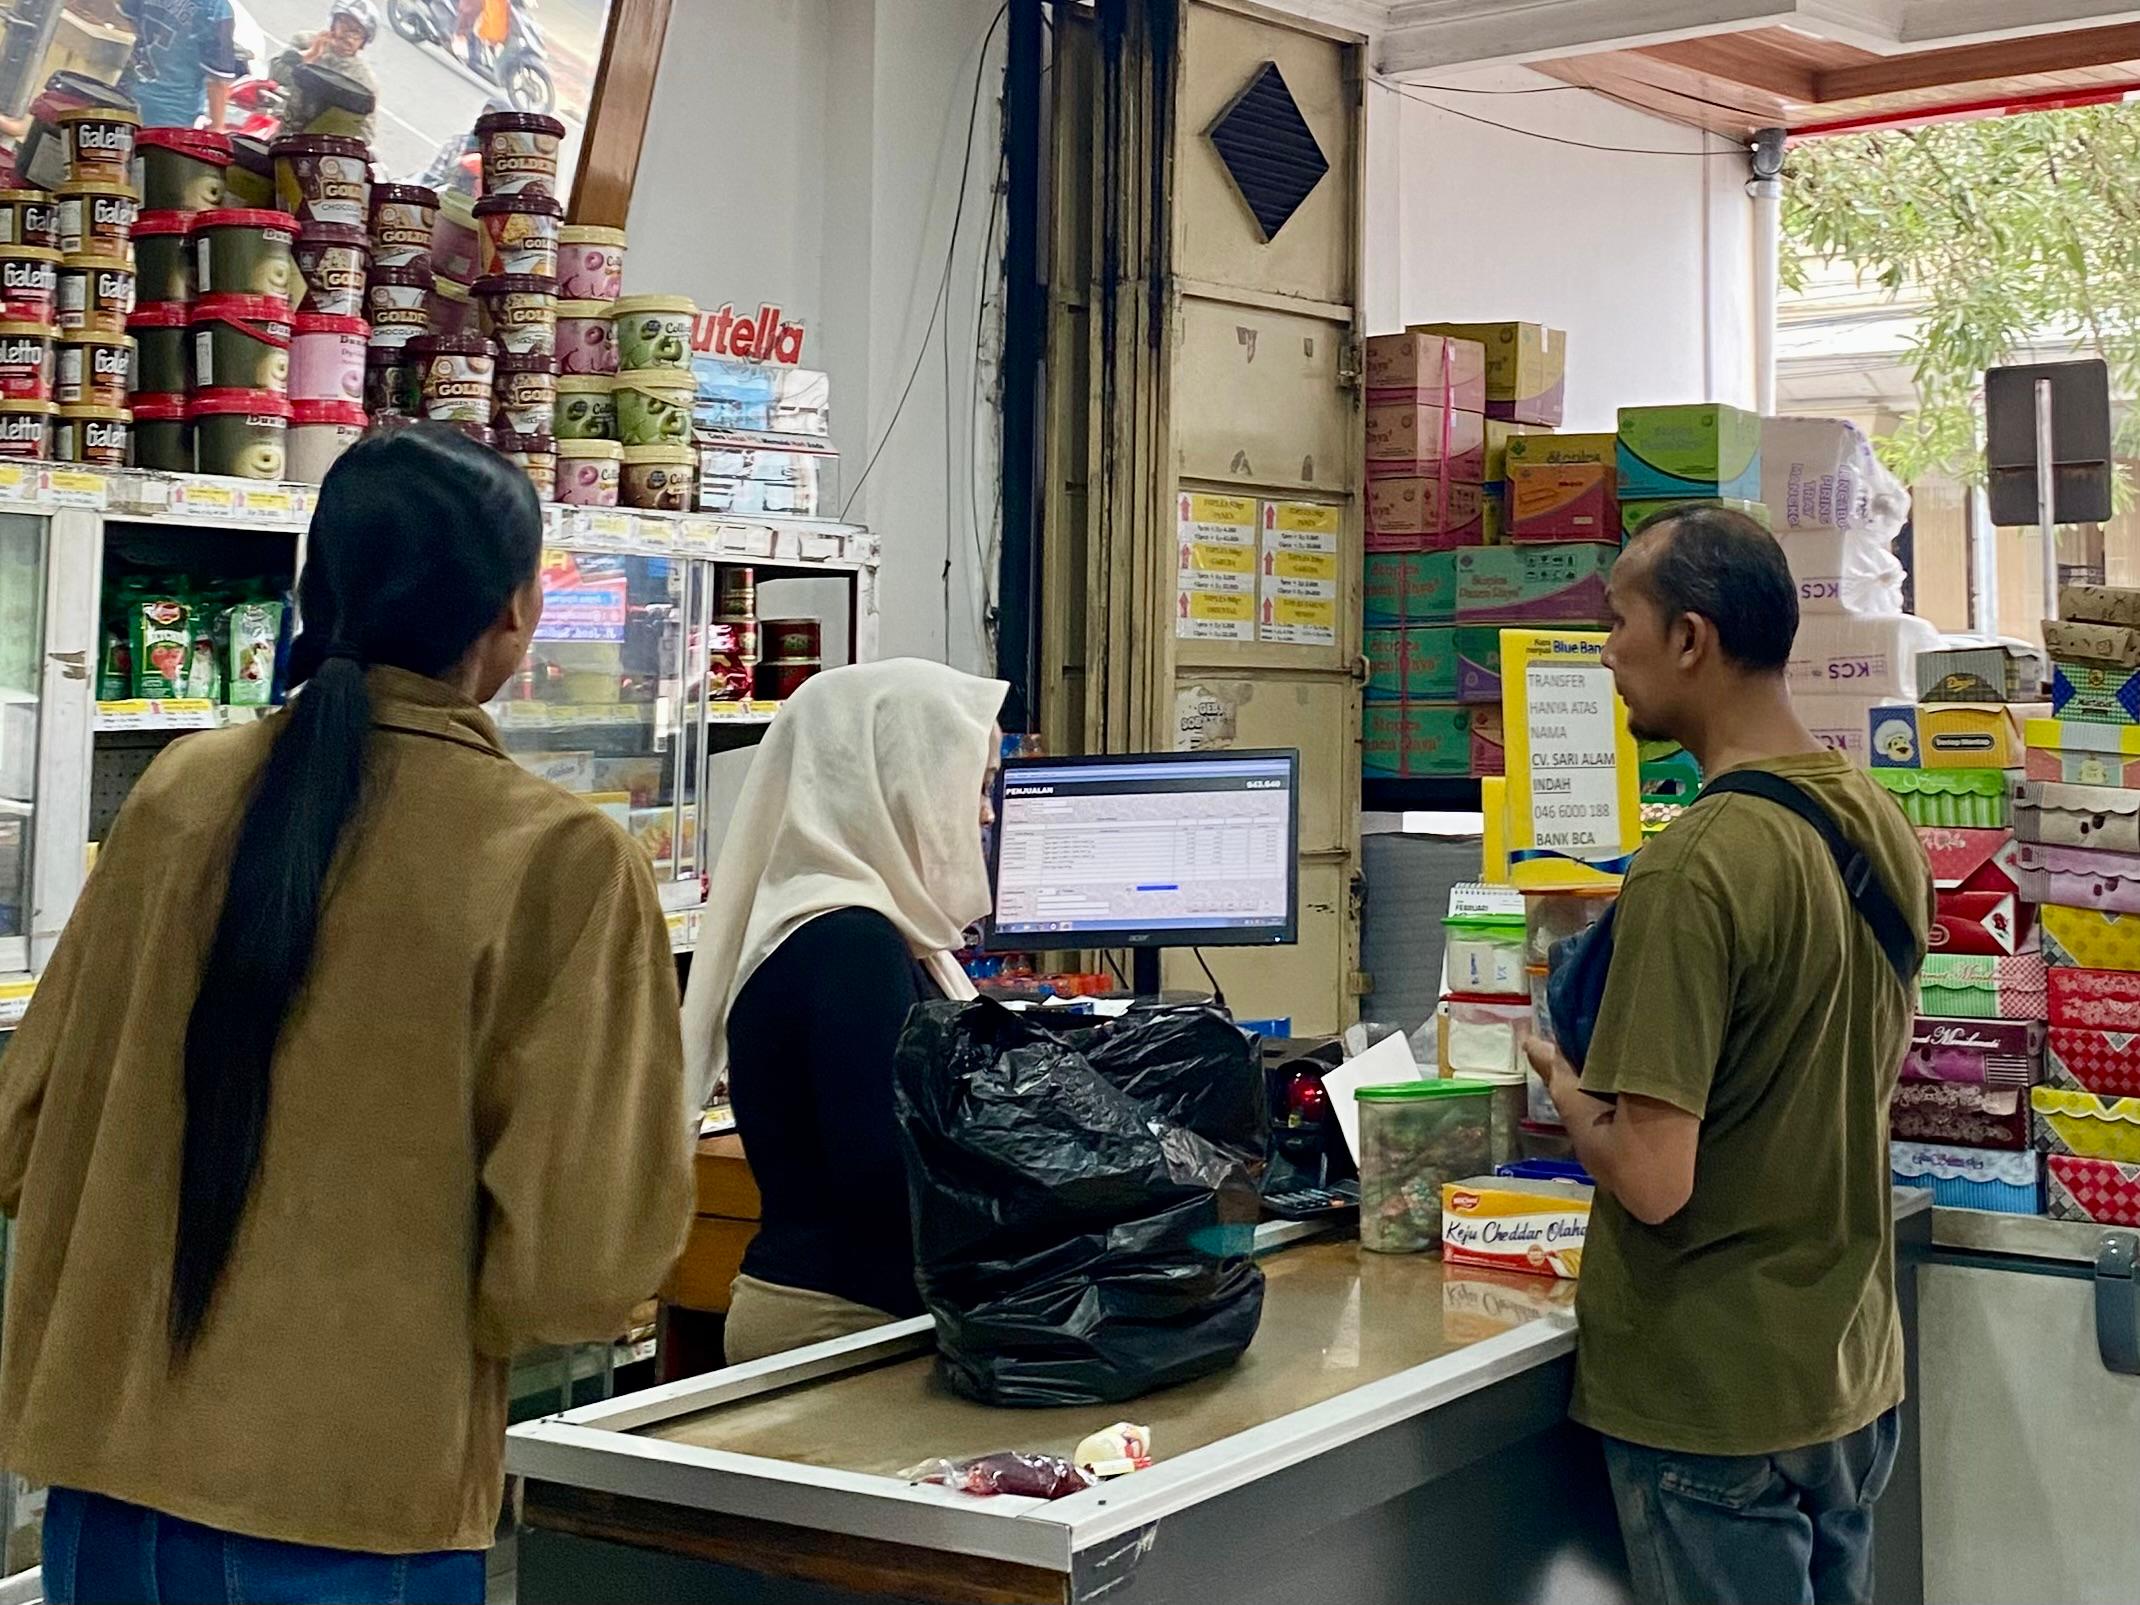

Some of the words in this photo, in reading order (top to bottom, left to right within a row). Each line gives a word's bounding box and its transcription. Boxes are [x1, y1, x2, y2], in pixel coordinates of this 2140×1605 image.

[1801, 582, 1839, 599] KCS
[1553, 640, 1579, 654] Blue
[1828, 662, 1870, 679] KCS
[1528, 673, 1586, 688] TRANSFER
[1530, 701, 1569, 715] HANYA
[1571, 701, 1598, 714] ATAS
[1531, 726, 1567, 739] NAMA
[1532, 753, 1550, 766] CV.
[1553, 753, 1578, 766] SARI
[1581, 753, 1616, 765] ALAM
[1005, 786, 1055, 796] PENJUALAN
[1533, 778, 1571, 791] INDAH
[1534, 805, 1556, 819] 046
[1559, 804, 1586, 818] 6000
[1590, 803, 1610, 817] 188
[1536, 832, 1569, 846] BANK
[1572, 831, 1596, 845] BCA
[1447, 1220, 1477, 1245] Keju
[1483, 1221, 1544, 1244] Cheddar
